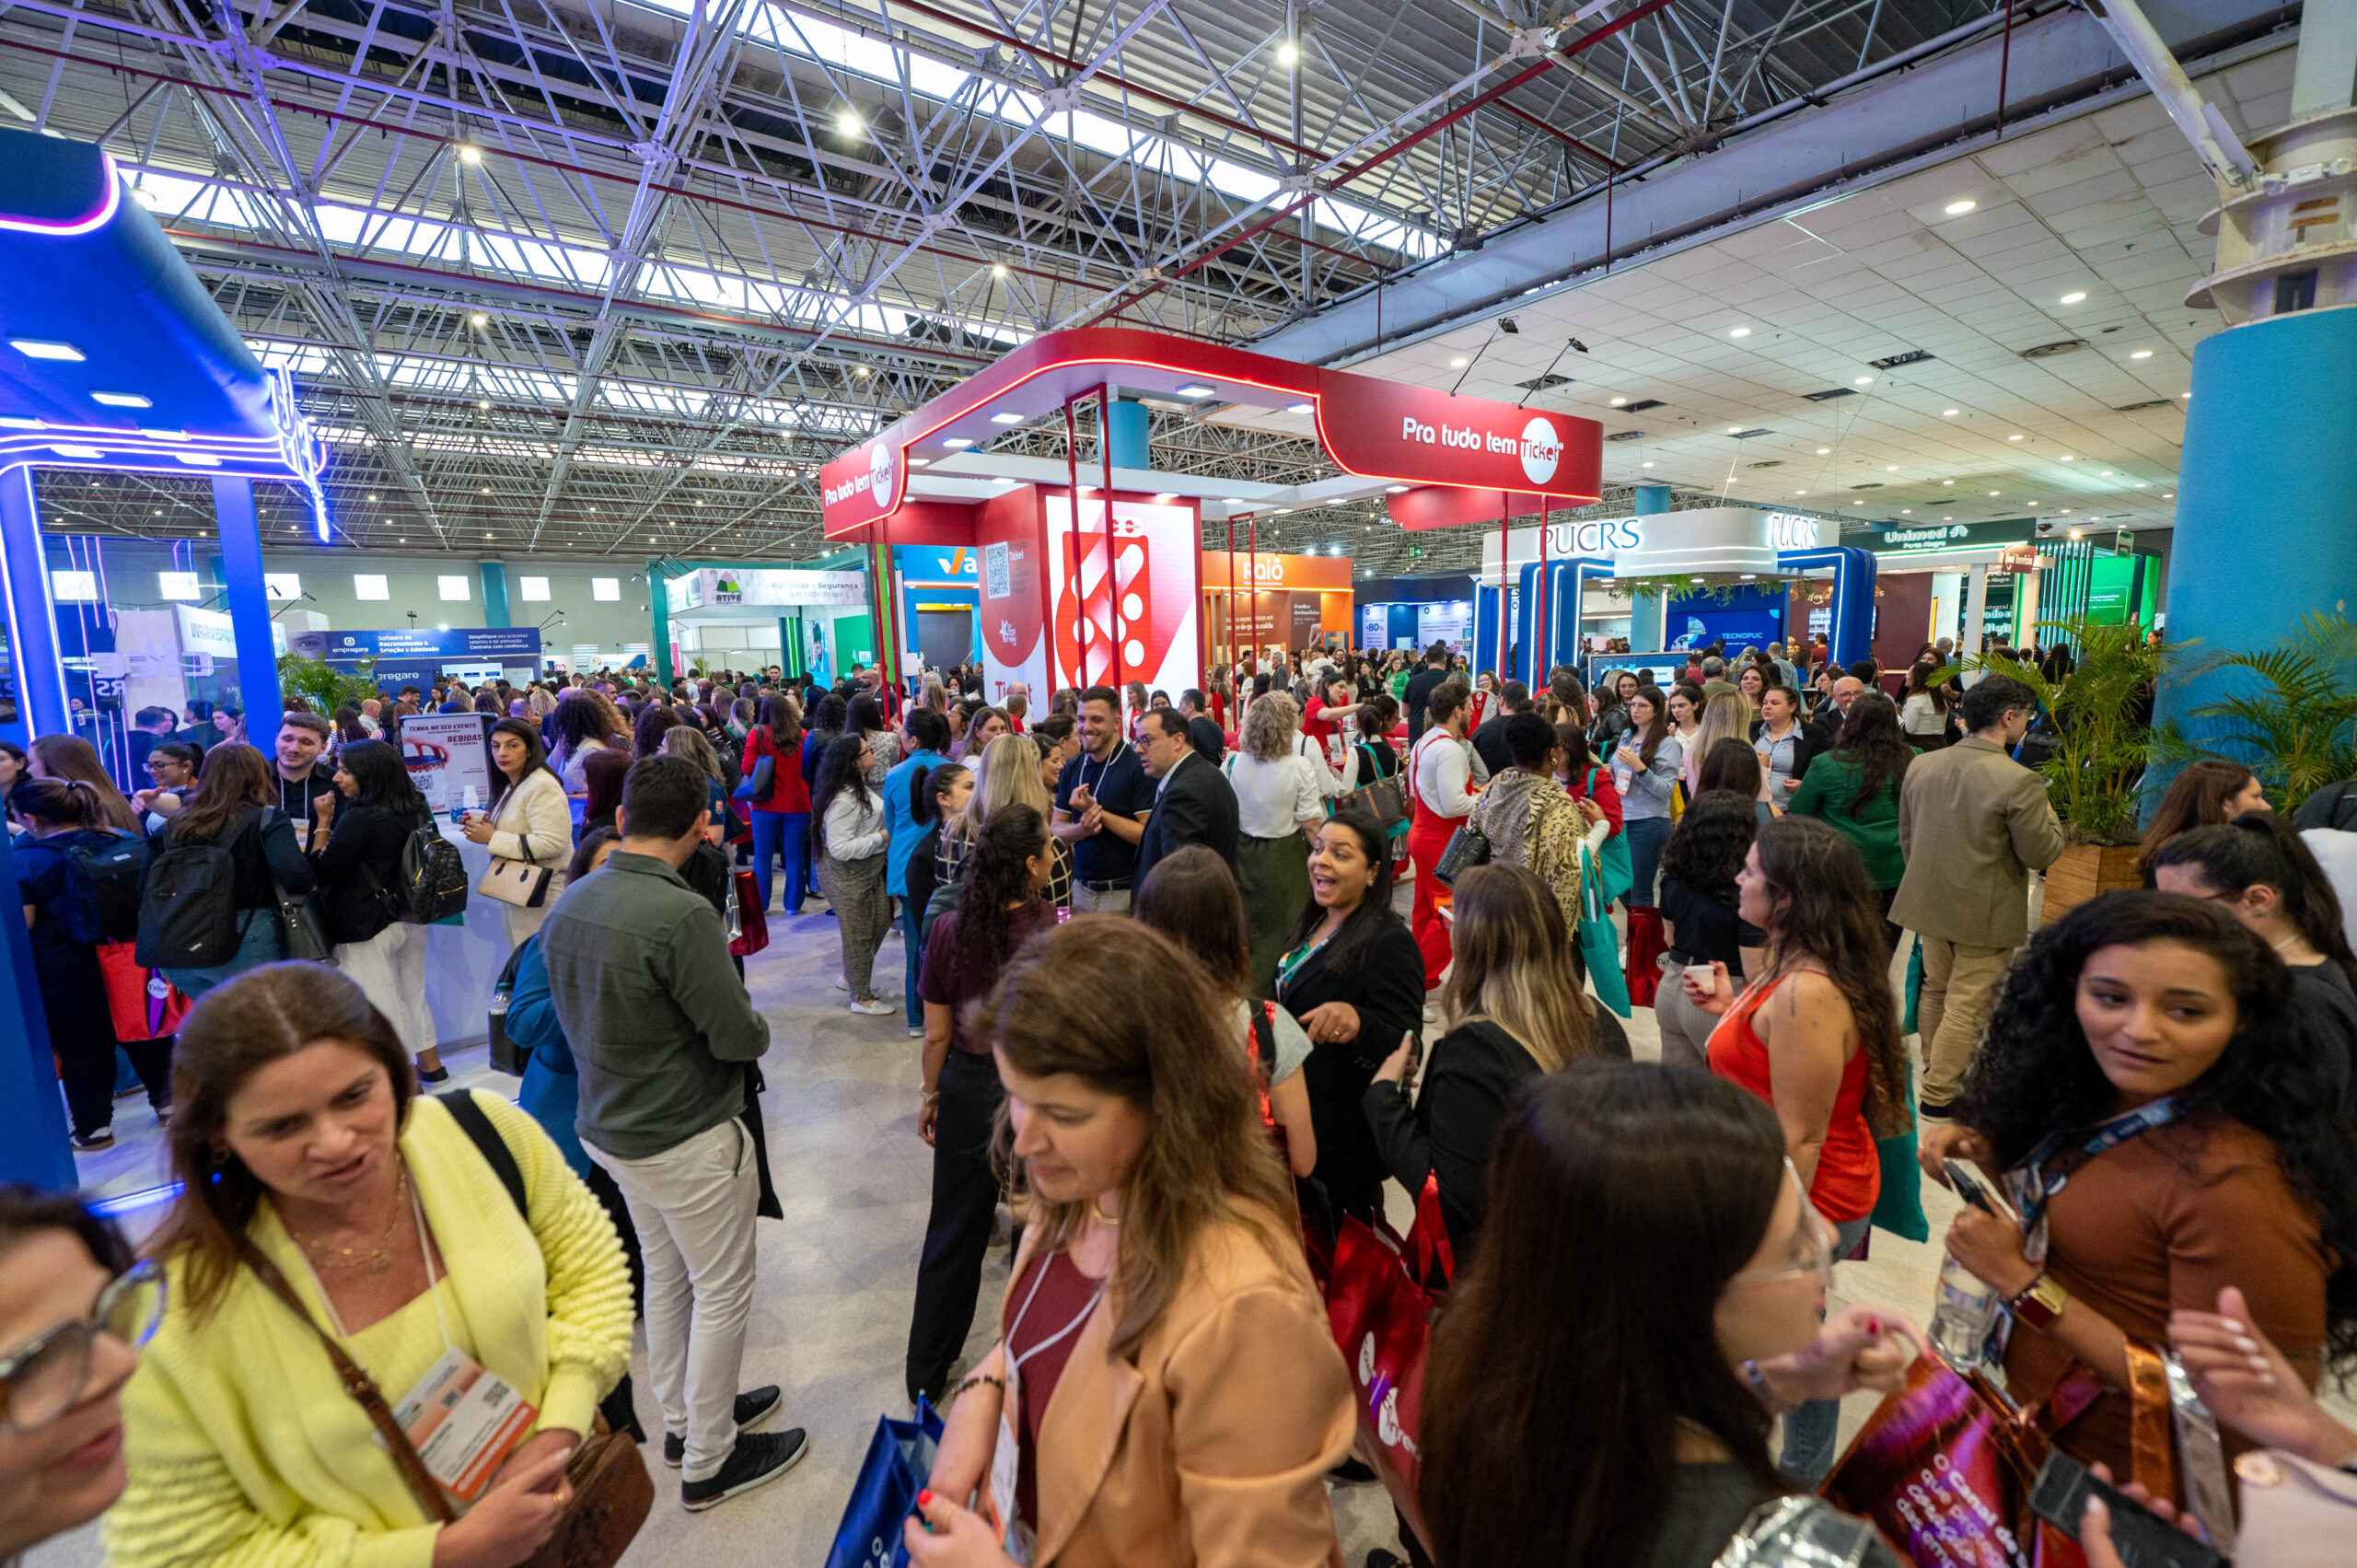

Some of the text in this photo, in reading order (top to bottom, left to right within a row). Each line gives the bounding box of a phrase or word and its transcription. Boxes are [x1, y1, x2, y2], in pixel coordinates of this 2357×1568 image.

[1402, 417, 1559, 462] Pra tudo tem Ticket
[824, 461, 893, 507] Pra tudo tem Ticket
[1538, 518, 1640, 556] PUCRS
[1771, 516, 1818, 549] PUCRS
[1884, 527, 1947, 543] Unimed
[1903, 540, 1946, 550] Porto Alegre
[1009, 550, 1024, 561] Ticket
[1244, 557, 1283, 581] Raiô
[716, 594, 742, 602] ATIVA
[447, 733, 482, 743] BEBIDAS
[1921, 1468, 1953, 1505] que
[1896, 1497, 1924, 1532] das
[1933, 1453, 2018, 1555] O Canal de
